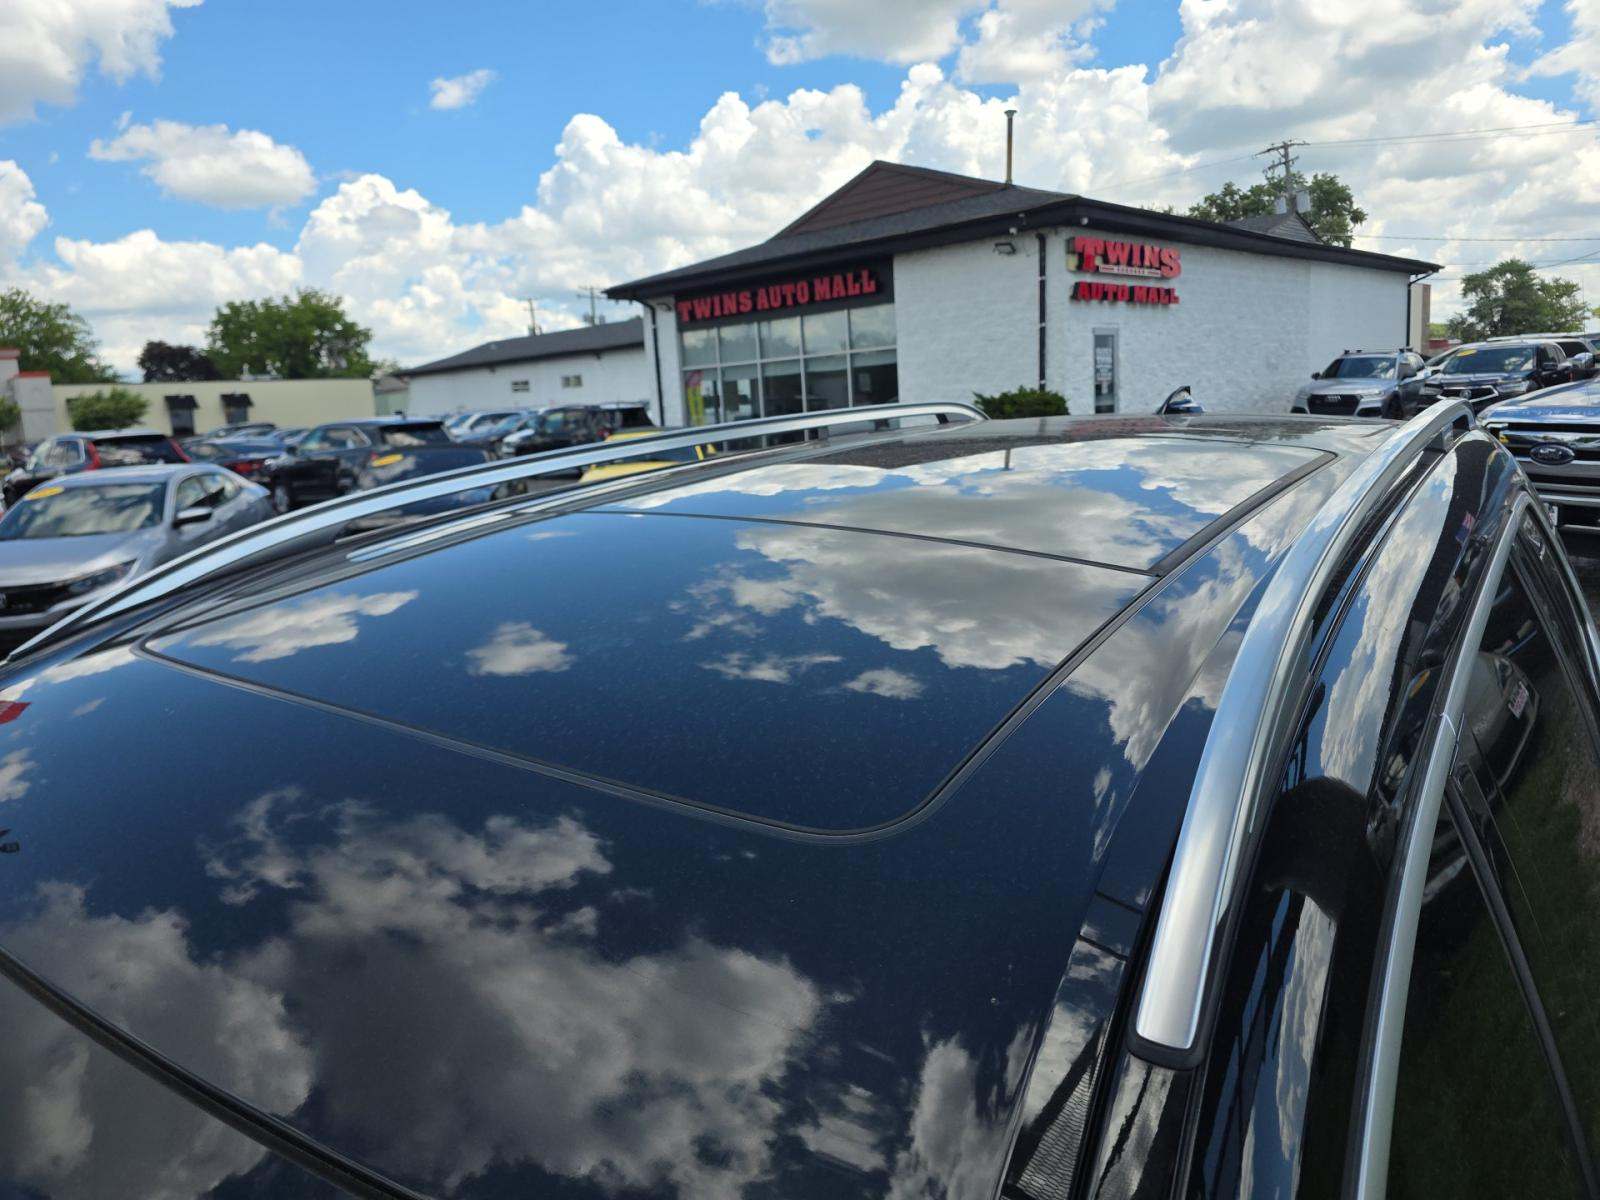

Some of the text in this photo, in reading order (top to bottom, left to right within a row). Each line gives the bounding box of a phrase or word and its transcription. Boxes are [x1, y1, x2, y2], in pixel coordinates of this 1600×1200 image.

[1073, 236, 1182, 278] TWINS
[677, 269, 876, 322] TWINS AUTO MALL
[1076, 281, 1180, 304] AUTO MALL
